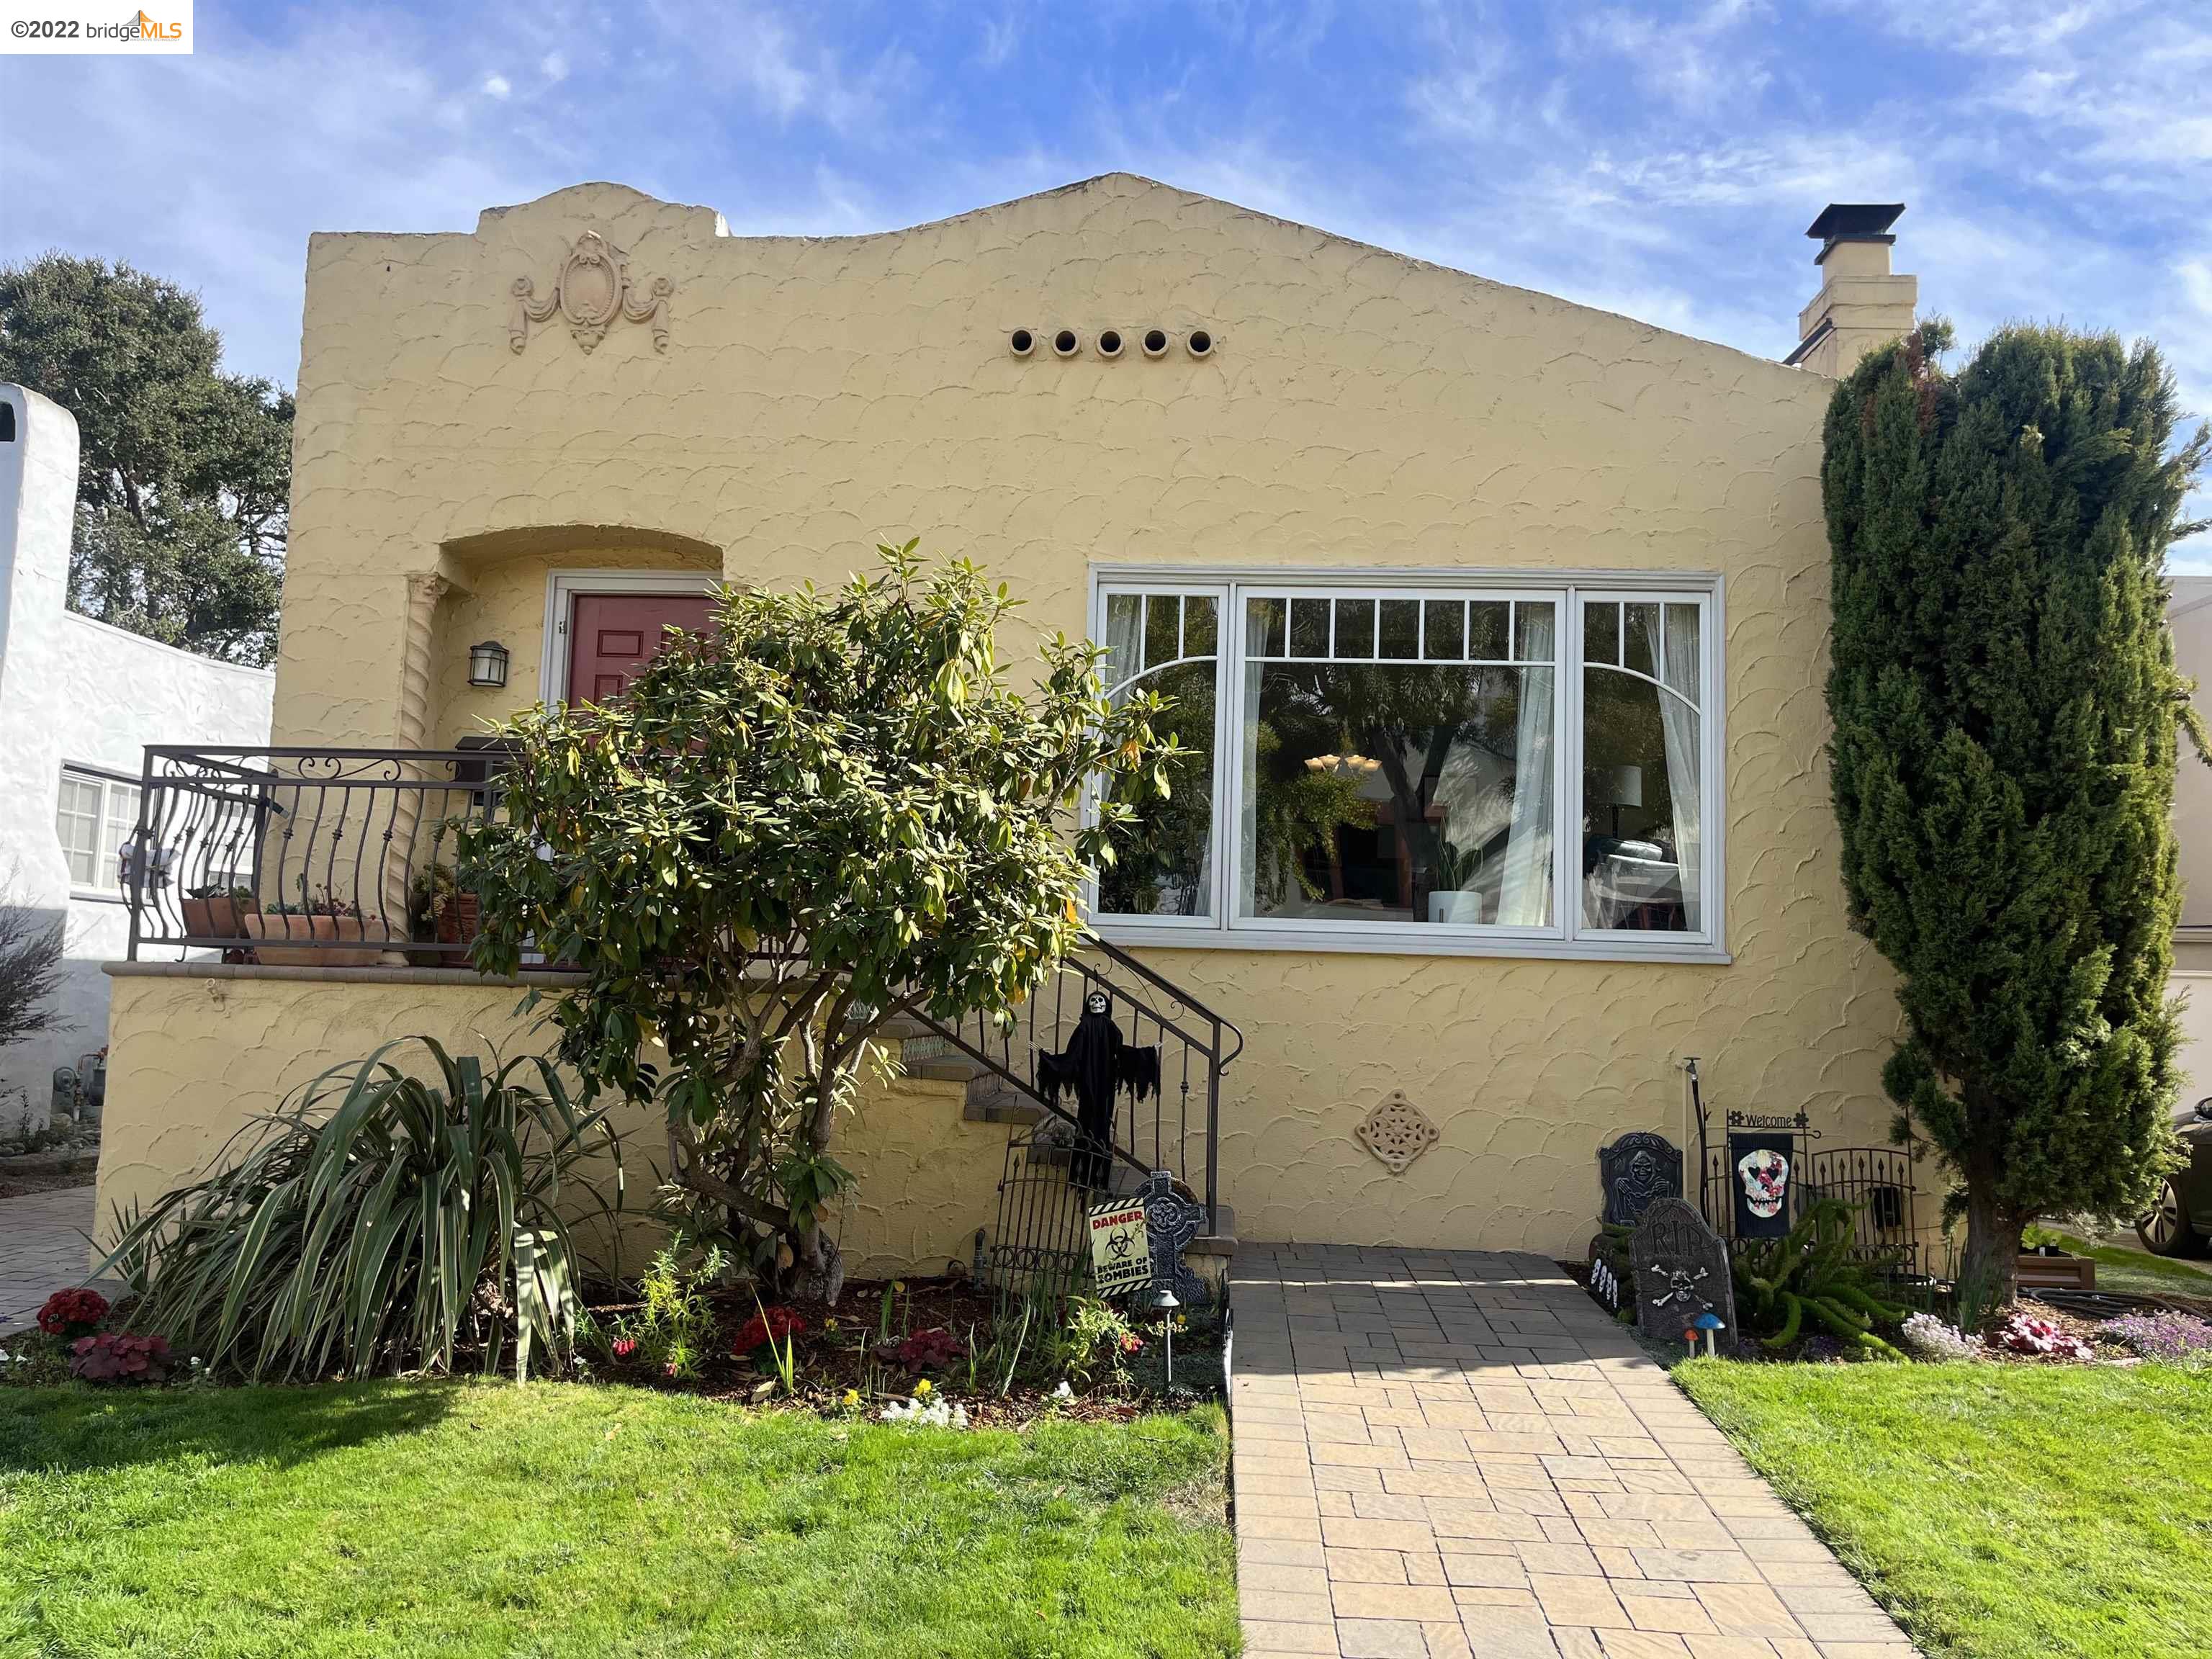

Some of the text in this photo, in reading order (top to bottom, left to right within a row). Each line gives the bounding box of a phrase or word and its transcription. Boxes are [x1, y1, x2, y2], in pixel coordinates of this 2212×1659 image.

[1745, 1114, 1792, 1127] Welcome
[1092, 1210, 1143, 1229] DANGER
[1097, 1259, 1132, 1274] BEWARE
[1098, 1265, 1148, 1284] ZOMBIES
